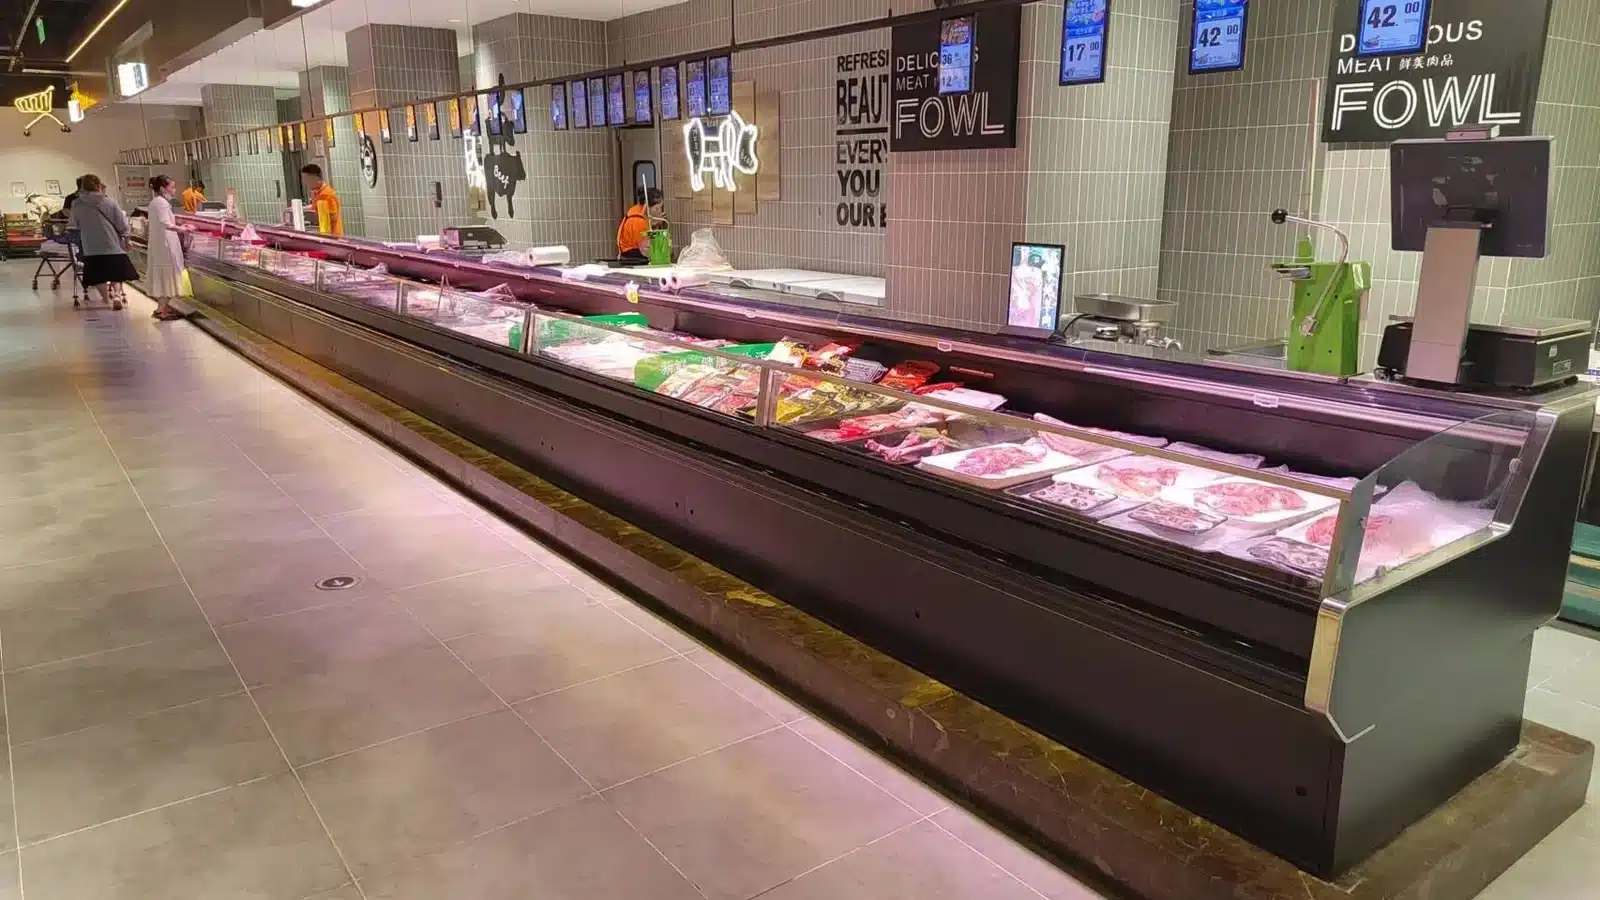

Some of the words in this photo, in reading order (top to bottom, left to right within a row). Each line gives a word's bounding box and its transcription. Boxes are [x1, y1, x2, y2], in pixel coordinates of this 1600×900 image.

[1404, 1, 1420, 14] 00
[896, 46, 979, 72] DELICS
[896, 74, 930, 91] MEAT
[1331, 73, 1521, 131] FOWL
[896, 91, 1005, 139] FOWL
[493, 164, 510, 189] Beef
[836, 202, 875, 227] OUR
